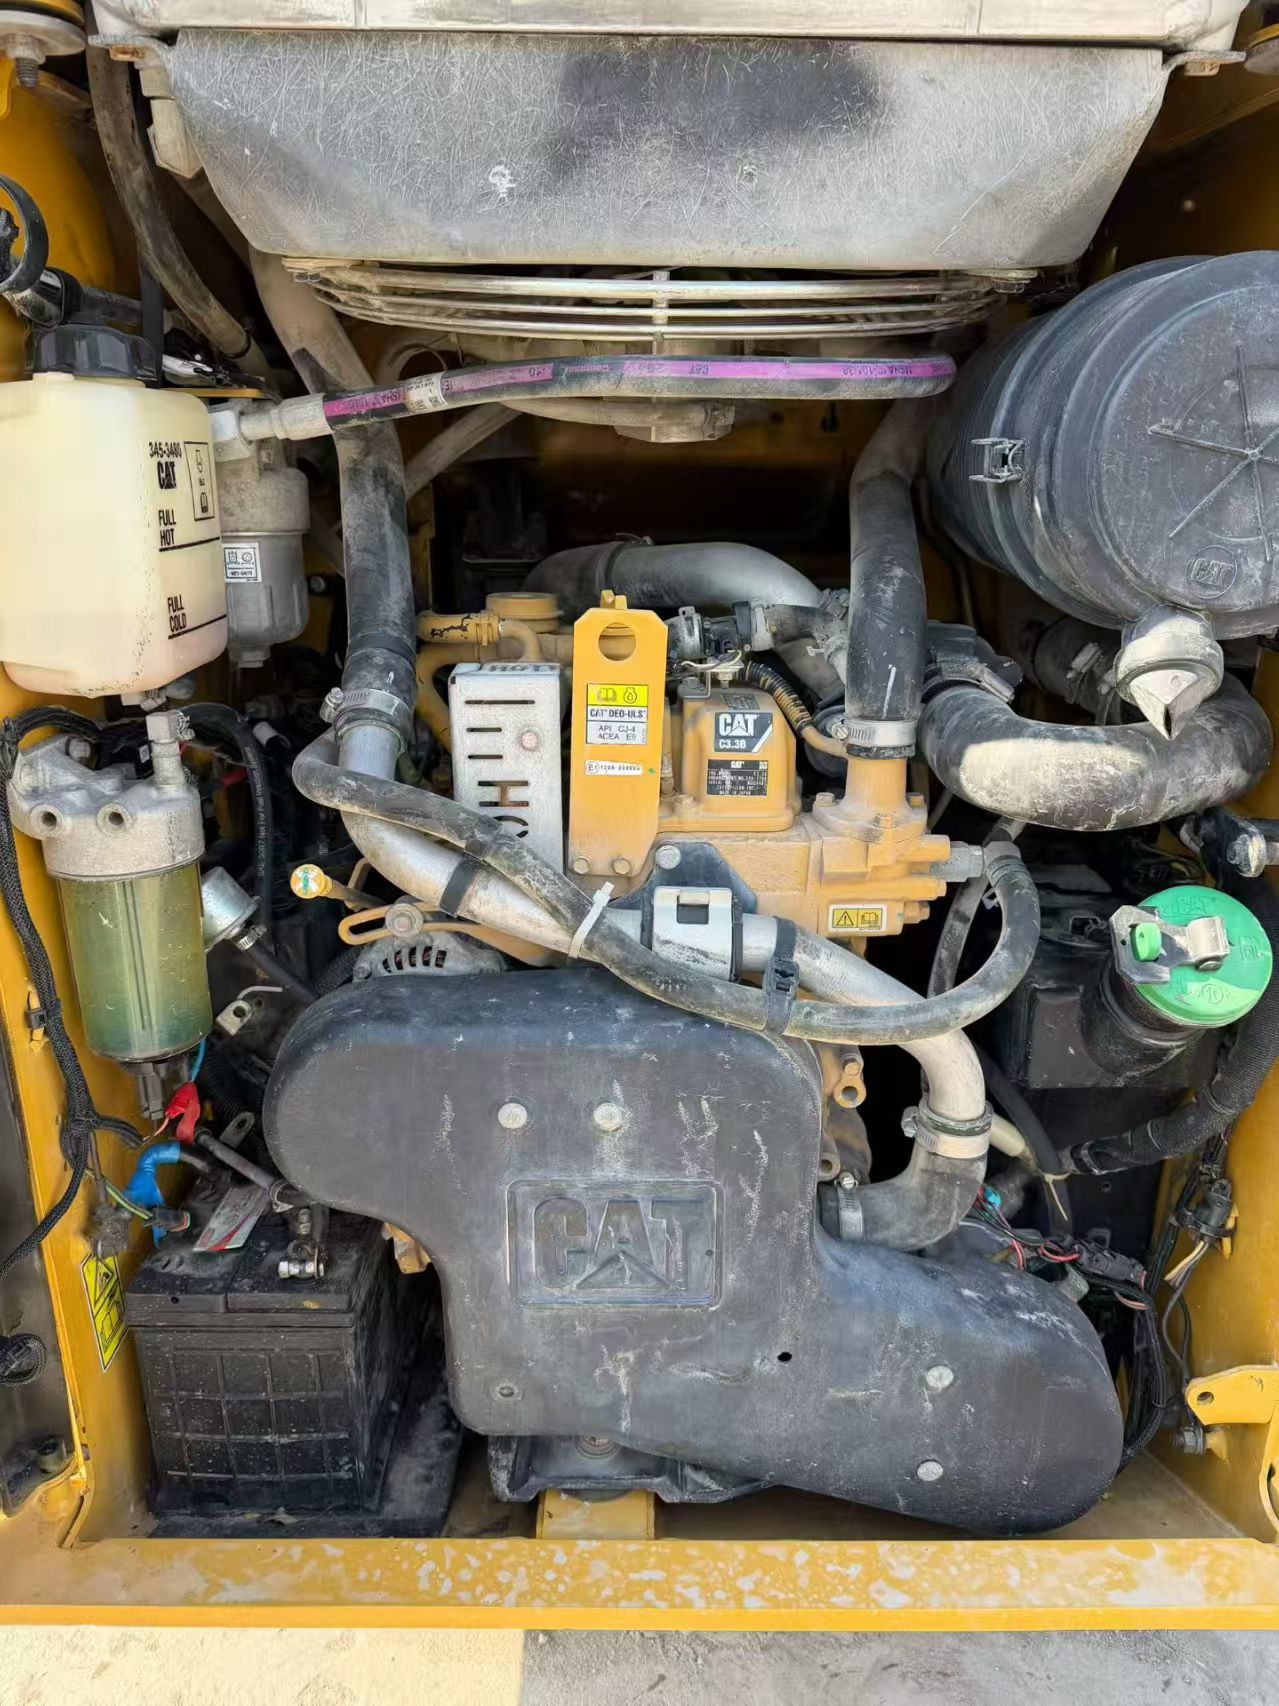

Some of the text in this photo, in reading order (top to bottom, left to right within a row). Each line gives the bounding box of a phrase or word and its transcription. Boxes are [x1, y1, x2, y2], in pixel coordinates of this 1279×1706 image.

[157, 461, 176, 490] CAT
[158, 508, 176, 527] FULL
[160, 528, 175, 546] HOT
[167, 594, 184, 613] FULL
[169, 613, 187, 632] COLD
[590, 708, 643, 718] CAT DEO-ULS
[618, 725, 636, 733] CJ-4
[719, 713, 757, 737] CAT
[719, 739, 747, 749] C3.3B
[532, 1197, 706, 1290] CAT
